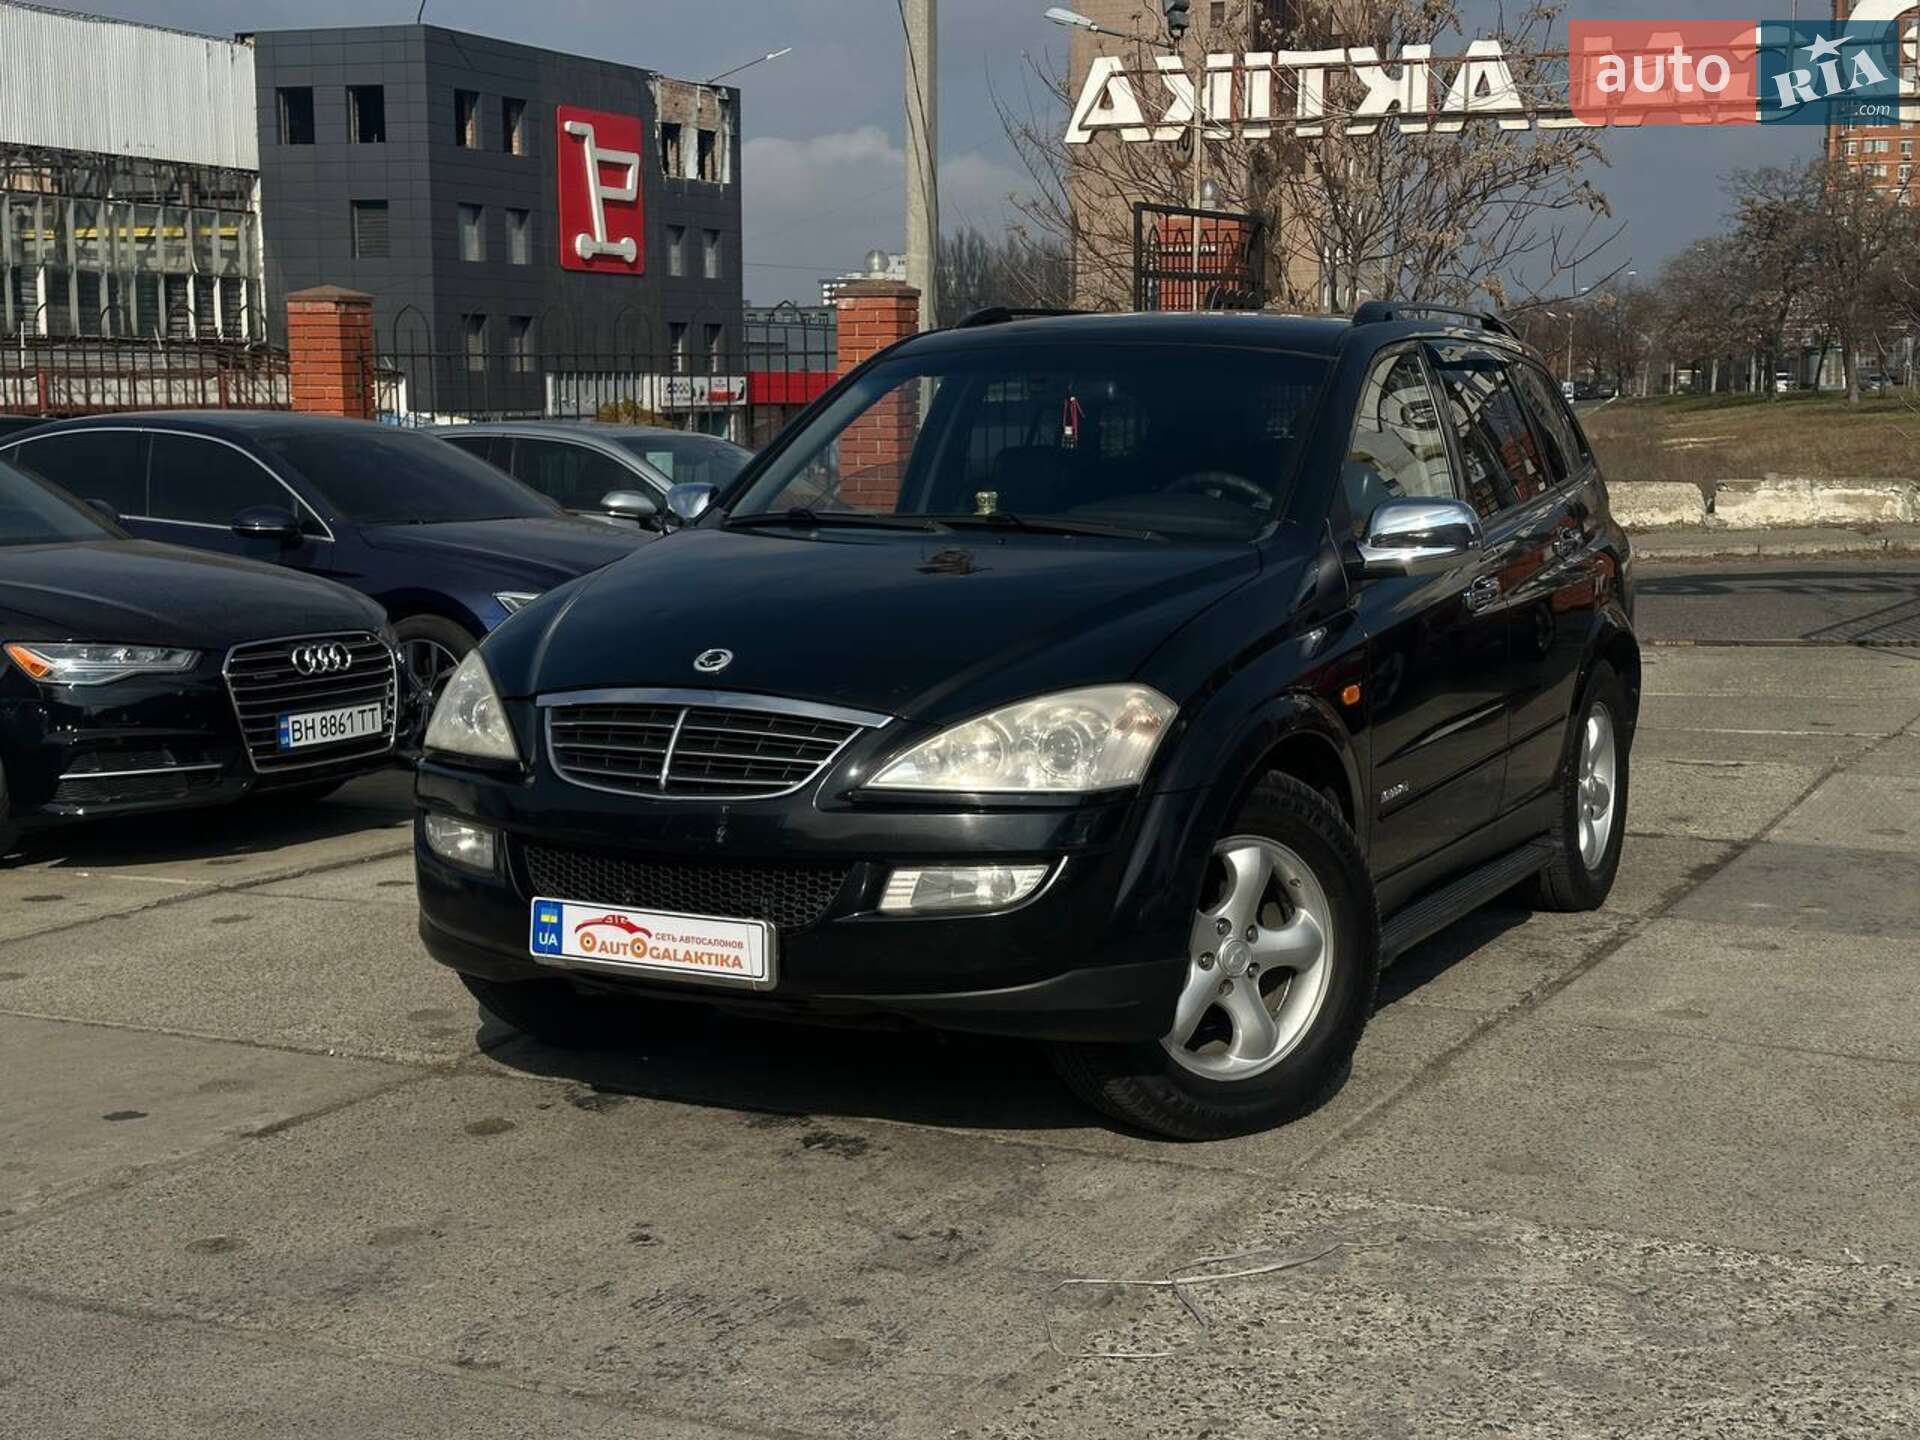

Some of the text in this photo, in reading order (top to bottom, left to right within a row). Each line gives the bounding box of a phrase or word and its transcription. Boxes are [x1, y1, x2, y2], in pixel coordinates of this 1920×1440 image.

[291, 718, 316, 742] BH
[320, 713, 354, 738] 8861
[358, 707, 378, 733] TT
[539, 931, 558, 946] UA
[655, 931, 744, 950] СЕТЬ АВТОСАЛОНОВ
